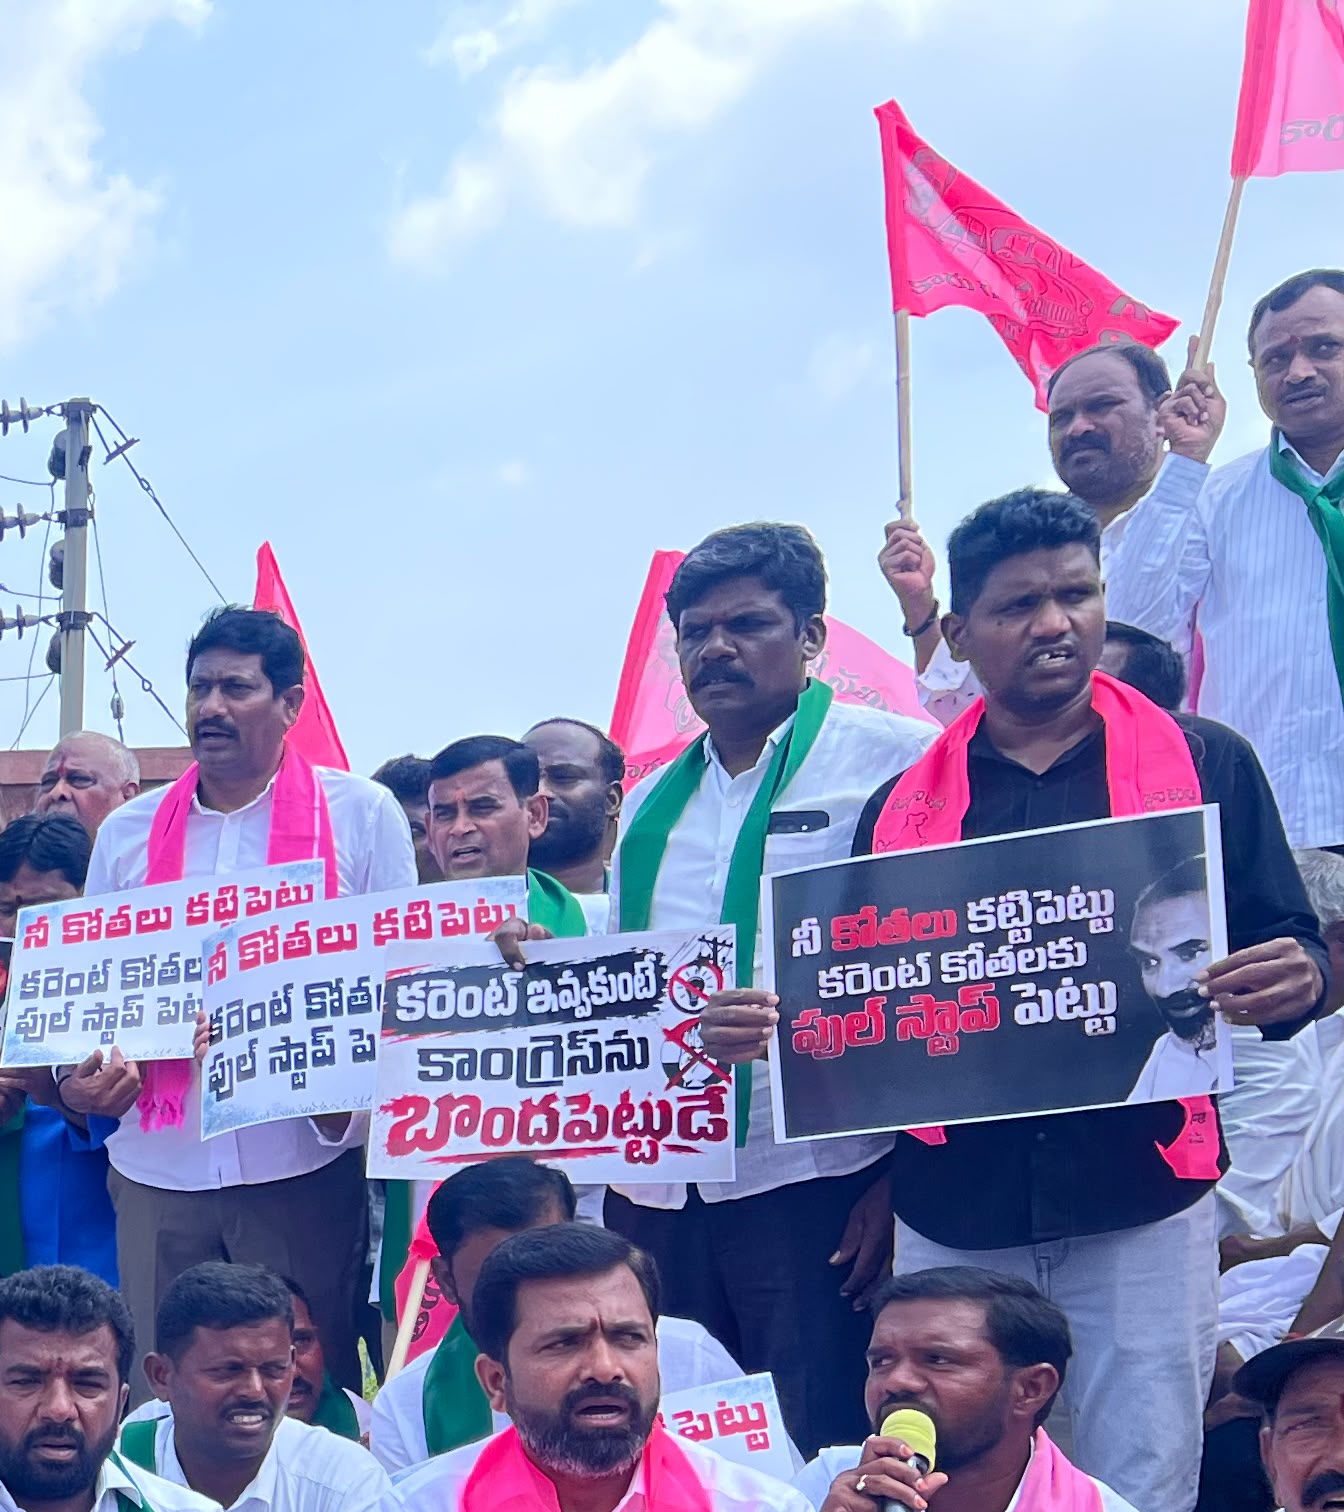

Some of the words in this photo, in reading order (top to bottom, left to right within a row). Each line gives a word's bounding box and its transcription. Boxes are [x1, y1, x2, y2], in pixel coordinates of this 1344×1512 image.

[23, 915, 49, 949] నీ
[62, 902, 172, 945] కోతలు
[238, 921, 357, 971] కోతలు
[791, 916, 822, 958] నీ
[831, 905, 957, 952] కోతలు
[19, 958, 112, 1000] కరెంట్
[120, 951, 202, 990] కోతల
[396, 972, 523, 1022] కరెంట్
[527, 951, 657, 1016] ఇవ్వకుంటే
[818, 951, 931, 999] కరెంట్
[940, 936, 1088, 985] కోతలకు
[1011, 978, 1117, 1036] పెట్టు
